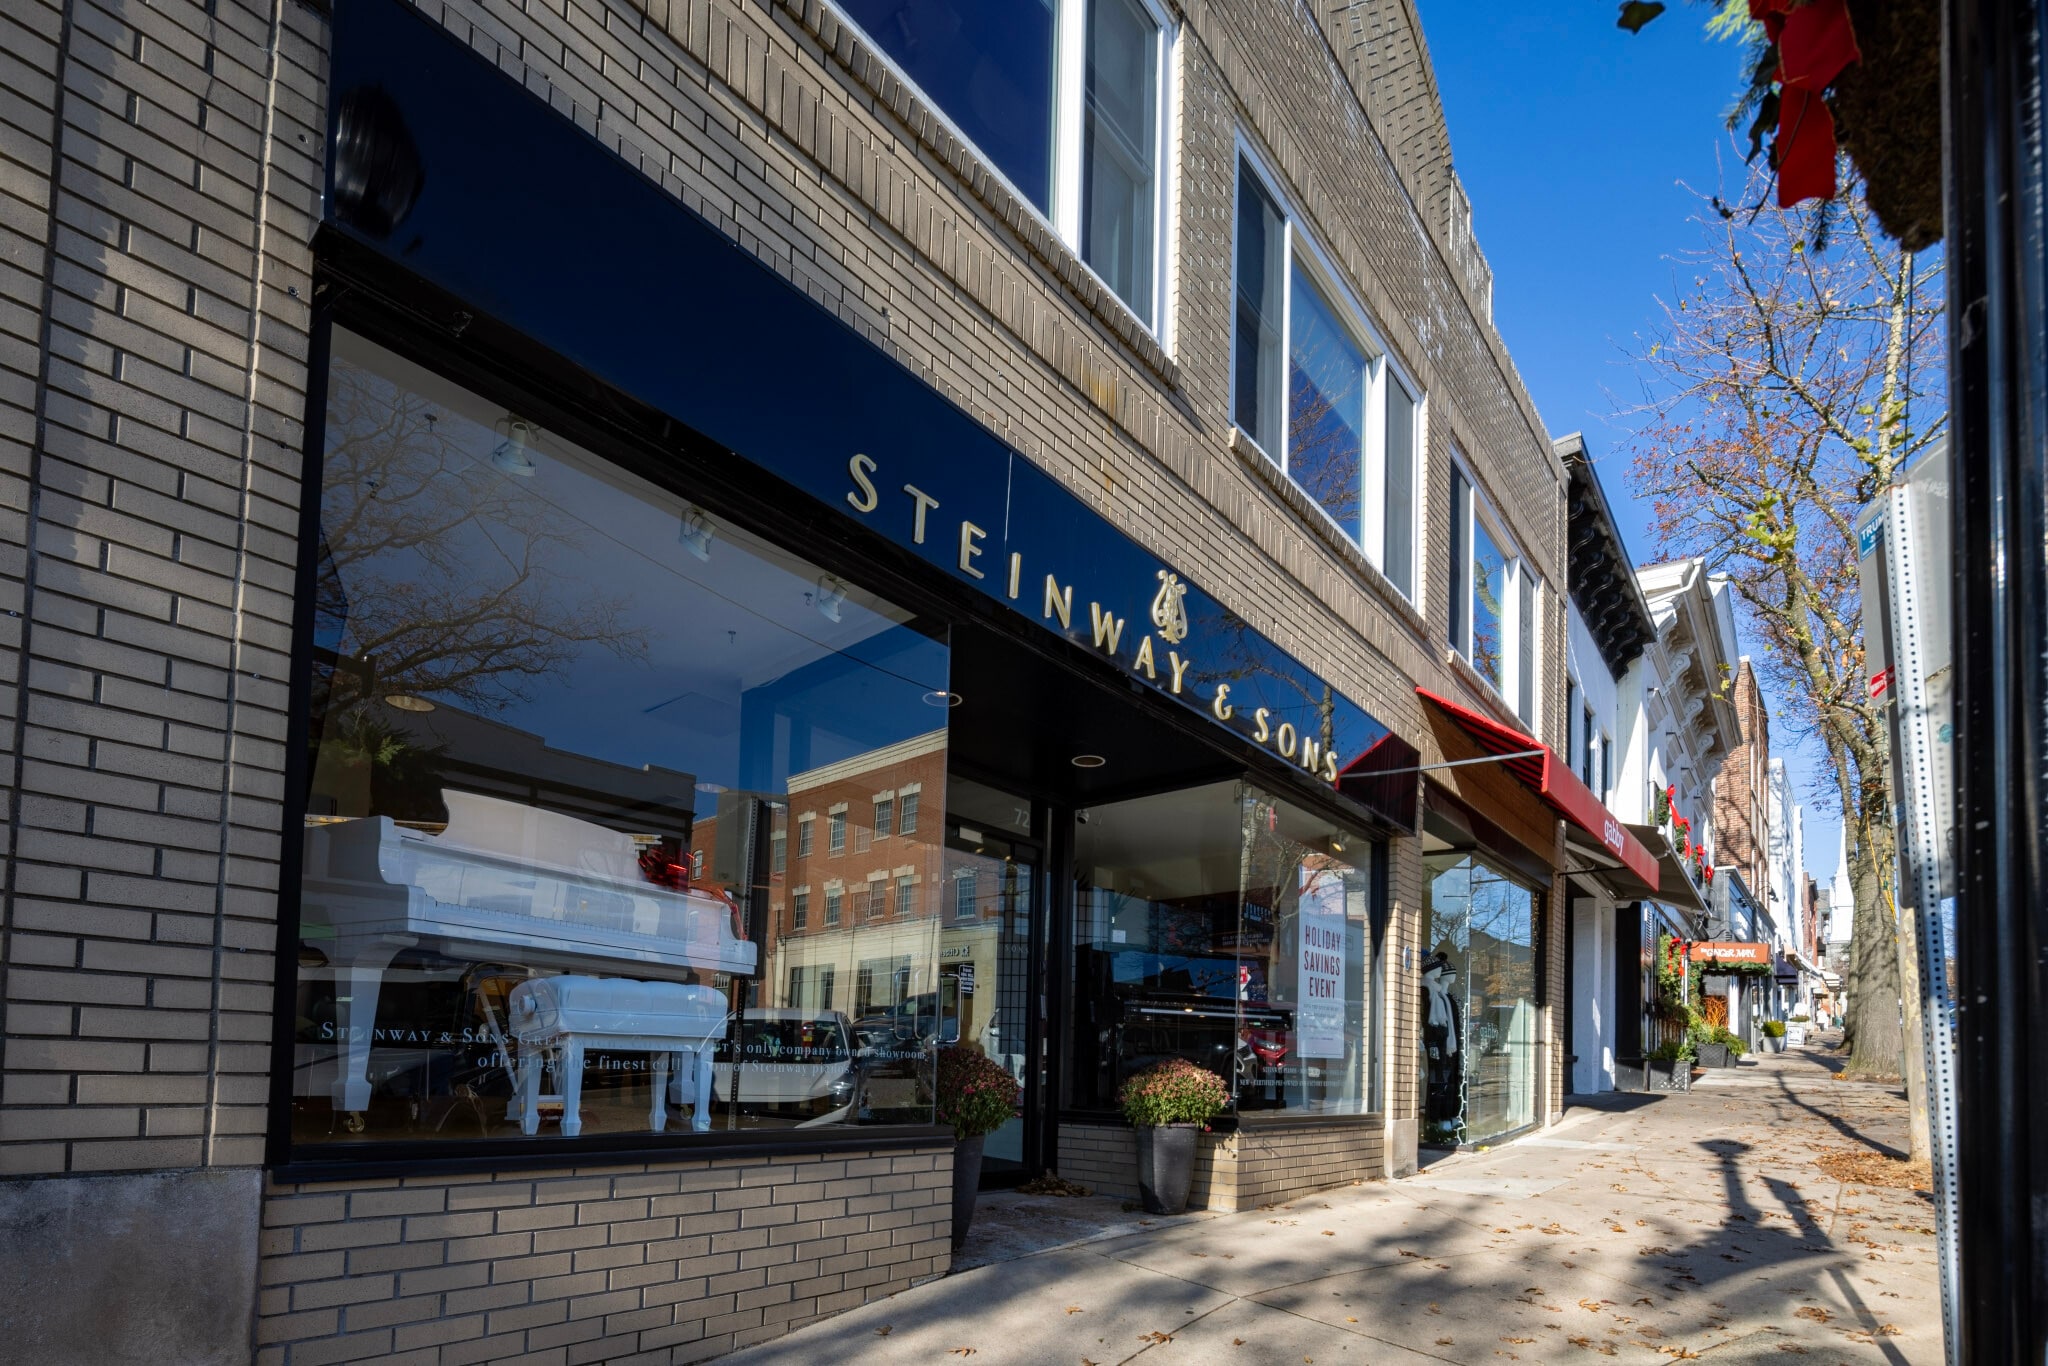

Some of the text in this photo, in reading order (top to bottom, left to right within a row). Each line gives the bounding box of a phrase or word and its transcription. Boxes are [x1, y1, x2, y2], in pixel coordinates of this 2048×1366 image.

[1861, 513, 1884, 541] TRUM
[847, 453, 1338, 782] STEINWAY & SONS
[1604, 819, 1624, 857] gabby
[1305, 924, 1341, 952] HOLIDAY
[1303, 952, 1340, 977] SAVINGS
[1309, 978, 1336, 999] EVENT
[321, 1021, 432, 1042] STINWAY
[746, 1042, 777, 1058] only
[780, 1045, 832, 1059] company
[599, 1055, 646, 1070] finest
[733, 1059, 746, 1072] of
[752, 1060, 807, 1076] Steinway
